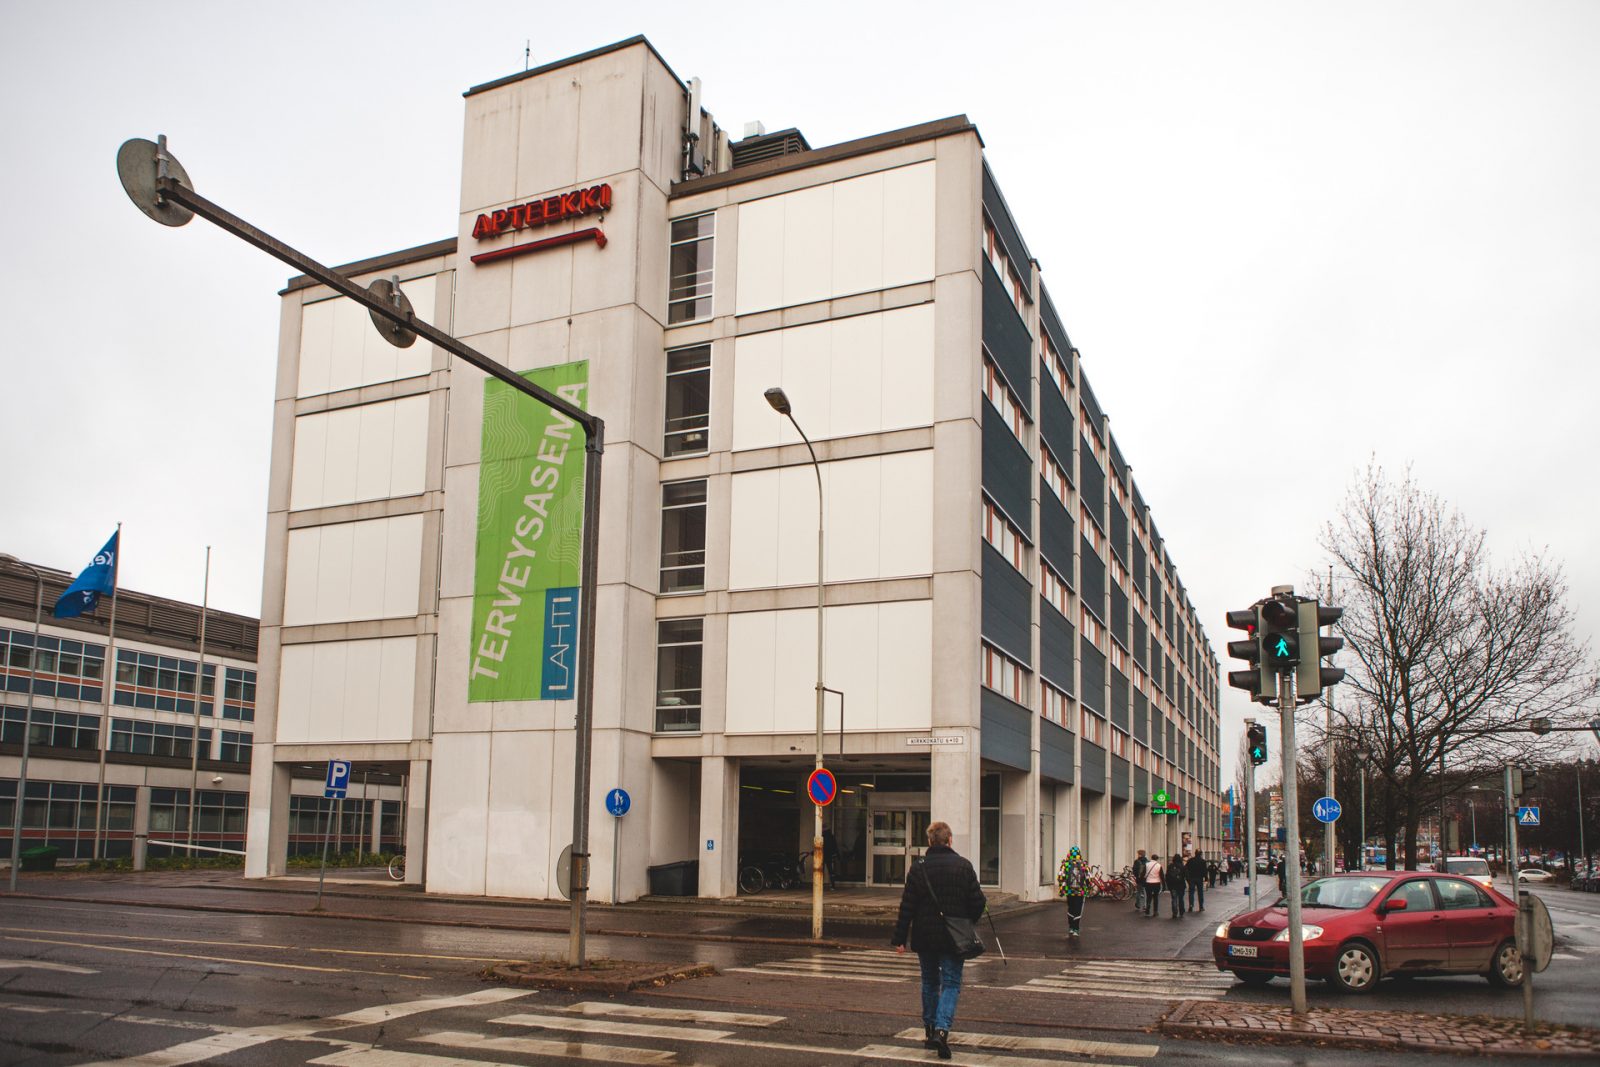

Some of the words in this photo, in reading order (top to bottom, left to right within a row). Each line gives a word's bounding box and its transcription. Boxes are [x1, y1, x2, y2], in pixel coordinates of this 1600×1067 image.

[472, 183, 612, 240] APTEEKKI
[470, 382, 588, 681] TERVEYSASEMA
[548, 597, 572, 691] LAHTI
[330, 762, 347, 787] P
